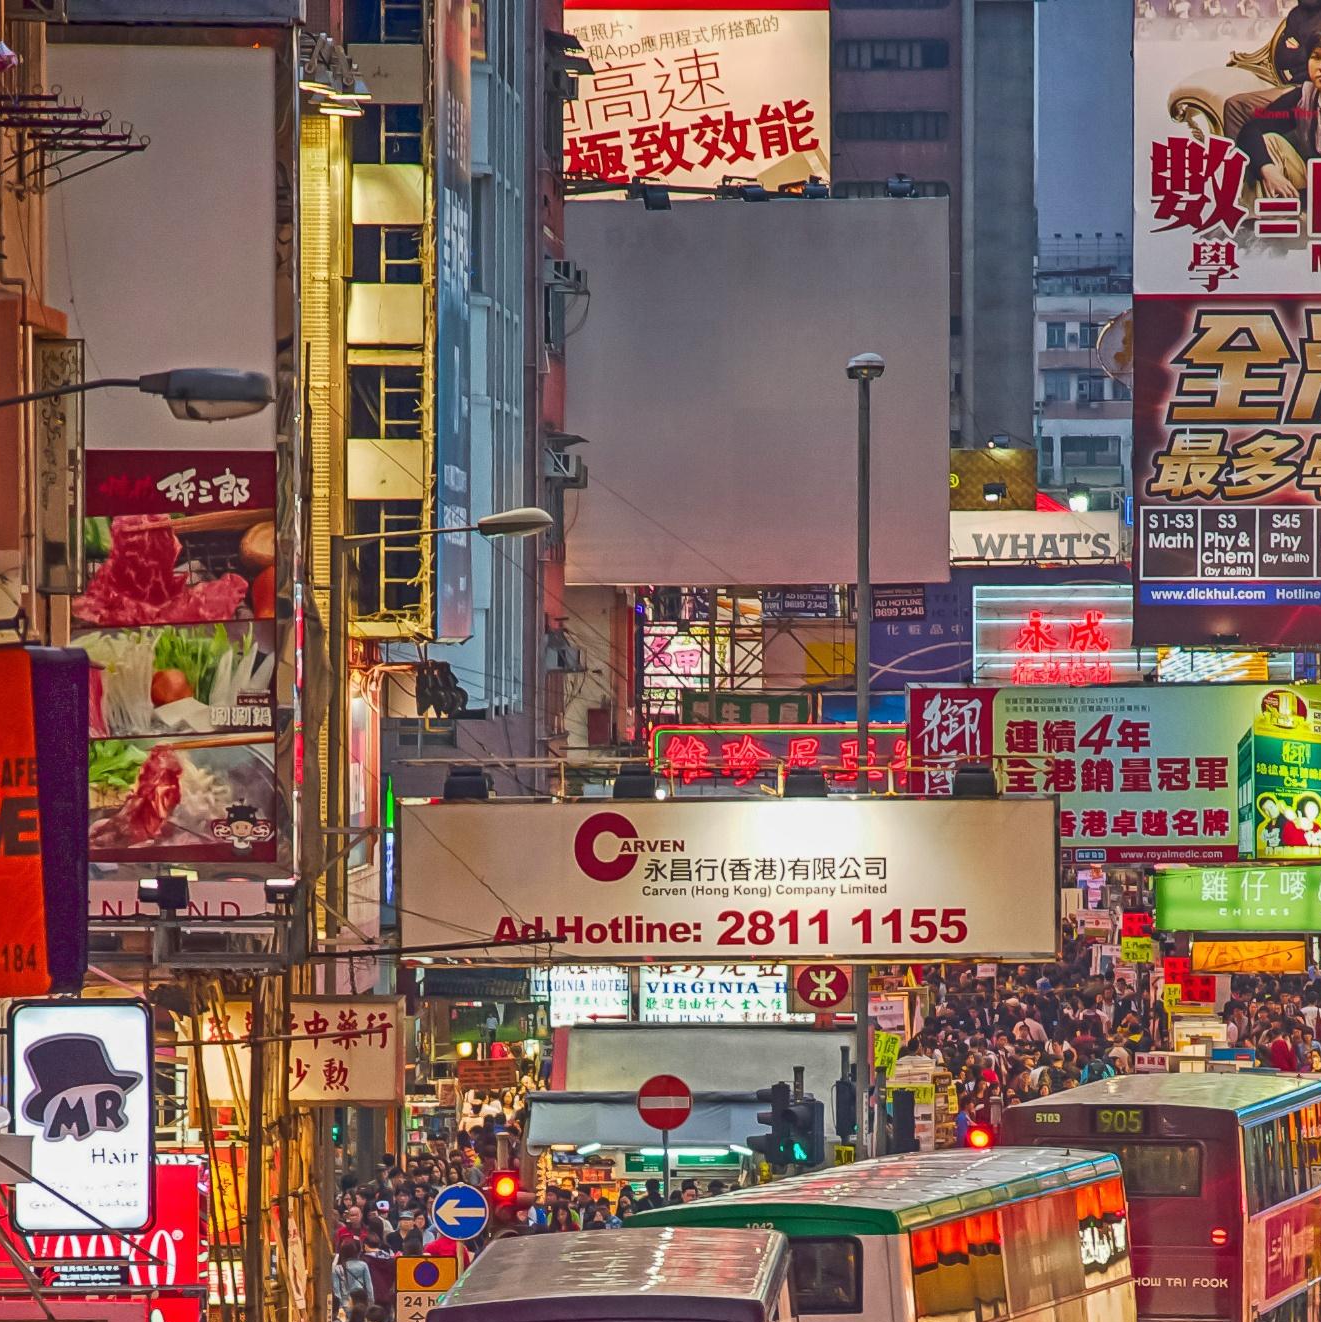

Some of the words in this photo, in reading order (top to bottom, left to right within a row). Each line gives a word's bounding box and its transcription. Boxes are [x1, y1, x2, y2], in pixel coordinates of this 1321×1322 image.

[563, 99, 819, 184] 極致效能
[1149, 136, 1247, 236] 數
[1189, 242, 1239, 292] 學
[157, 467, 250, 507] 孫三郎
[1218, 513, 1237, 528] S3
[1271, 513, 1301, 528] S45
[971, 531, 1112, 559] WHAT'S
[1149, 533, 1194, 549] Math
[1204, 533, 1235, 551] Phy
[1271, 533, 1302, 551] Phy
[1202, 549, 1254, 565] chem
[1151, 587, 1266, 601] www.dickhui.com
[1276, 588, 1320, 600] Hotline
[900, 607, 924, 617] 2348
[1005, 714, 1151, 755] 連續4年
[1005, 757, 1229, 793] 全港銷量冠軍
[1120, 850, 1223, 861] www.royalmedic.com
[644, 857, 887, 882] 永昌行(香港)有限公司
[642, 886, 687, 897] Carven
[691, 885, 729, 898] (Hong
[733, 884, 771, 898] Kong)
[776, 885, 836, 898] Company
[840, 884, 887, 895] Limited
[492, 916, 543, 943] Ad
[557, 914, 702, 943] Hotline:
[717, 909, 829, 945] 2811
[852, 908, 968, 945] 1155
[591, 979, 629, 992] HOTEL
[647, 981, 760, 994] VIRGINIA
[47, 1090, 125, 1138] MR
[1036, 1112, 1060, 1124] 5103
[1097, 1109, 1144, 1134] 905
[92, 1148, 139, 1165] Hair
[1166, 1278, 1187, 1288] TAI
[1193, 1278, 1229, 1288] FOOK
[404, 1296, 423, 1307] 24
